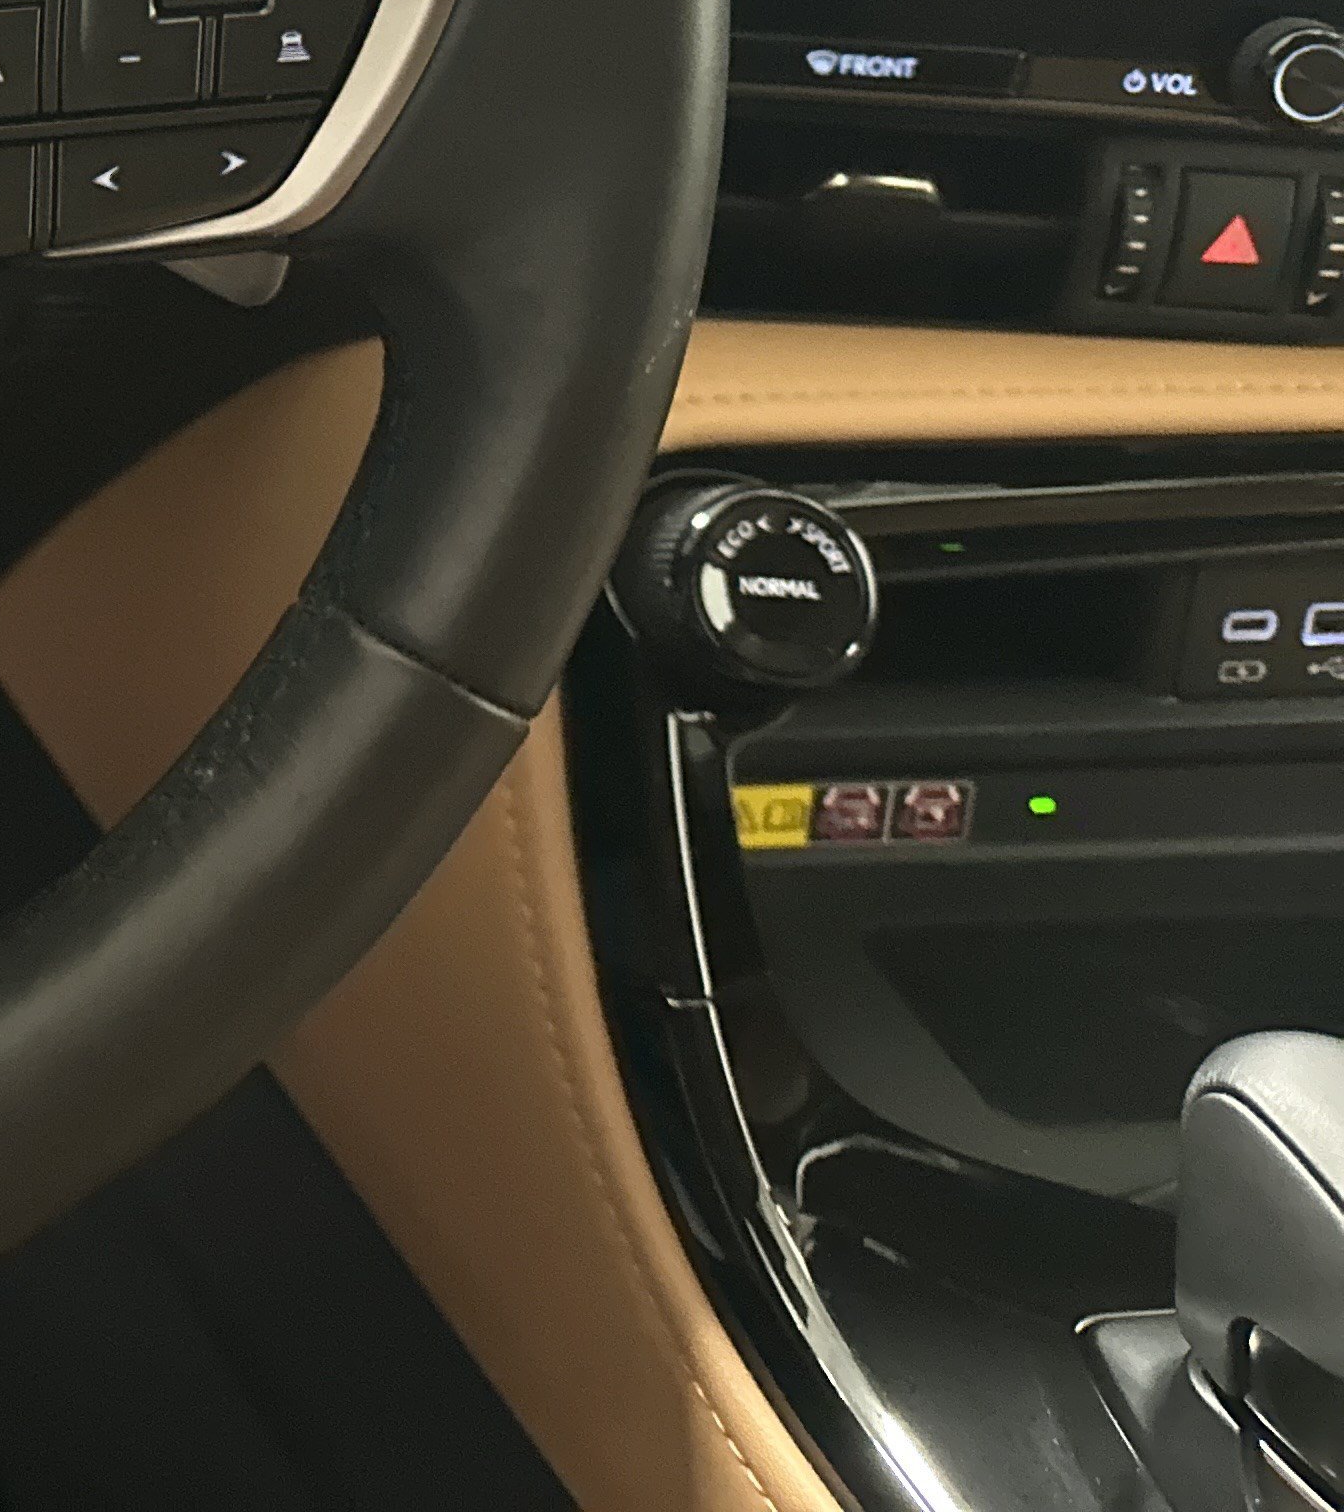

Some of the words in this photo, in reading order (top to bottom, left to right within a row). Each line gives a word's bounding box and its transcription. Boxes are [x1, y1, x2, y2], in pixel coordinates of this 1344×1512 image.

[837, 52, 919, 80] FRONT
[1149, 72, 1199, 97] VOL
[716, 519, 758, 561] ECO
[800, 522, 853, 574] SPORT
[738, 575, 823, 602] NORMAL
